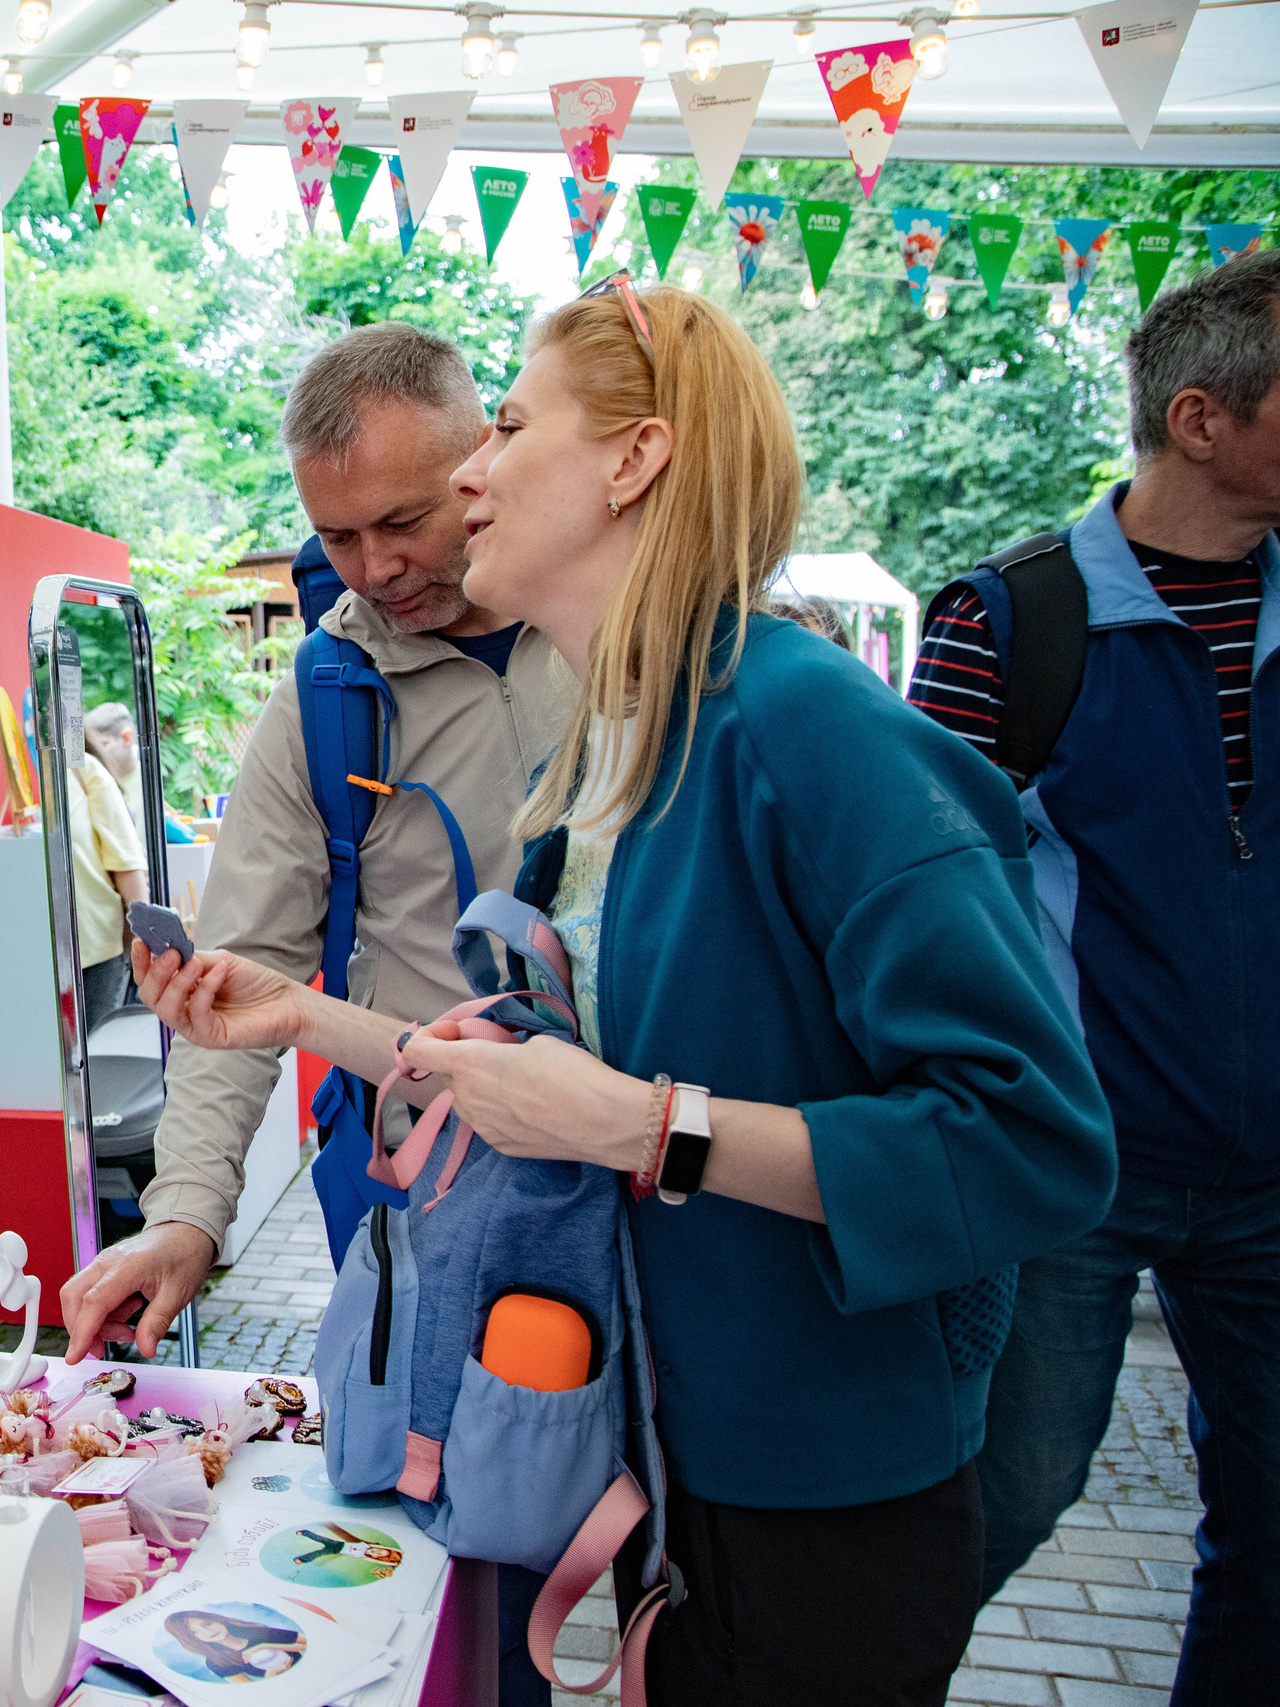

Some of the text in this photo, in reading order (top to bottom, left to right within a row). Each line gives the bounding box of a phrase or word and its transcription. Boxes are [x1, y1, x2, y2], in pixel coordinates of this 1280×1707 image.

[483, 178, 518, 191] ЛЕТО
[808, 213, 841, 226] ЛЕТО
[1138, 235, 1170, 246] ЛЕТО
[224, 1517, 280, 1568] Будь собой!
